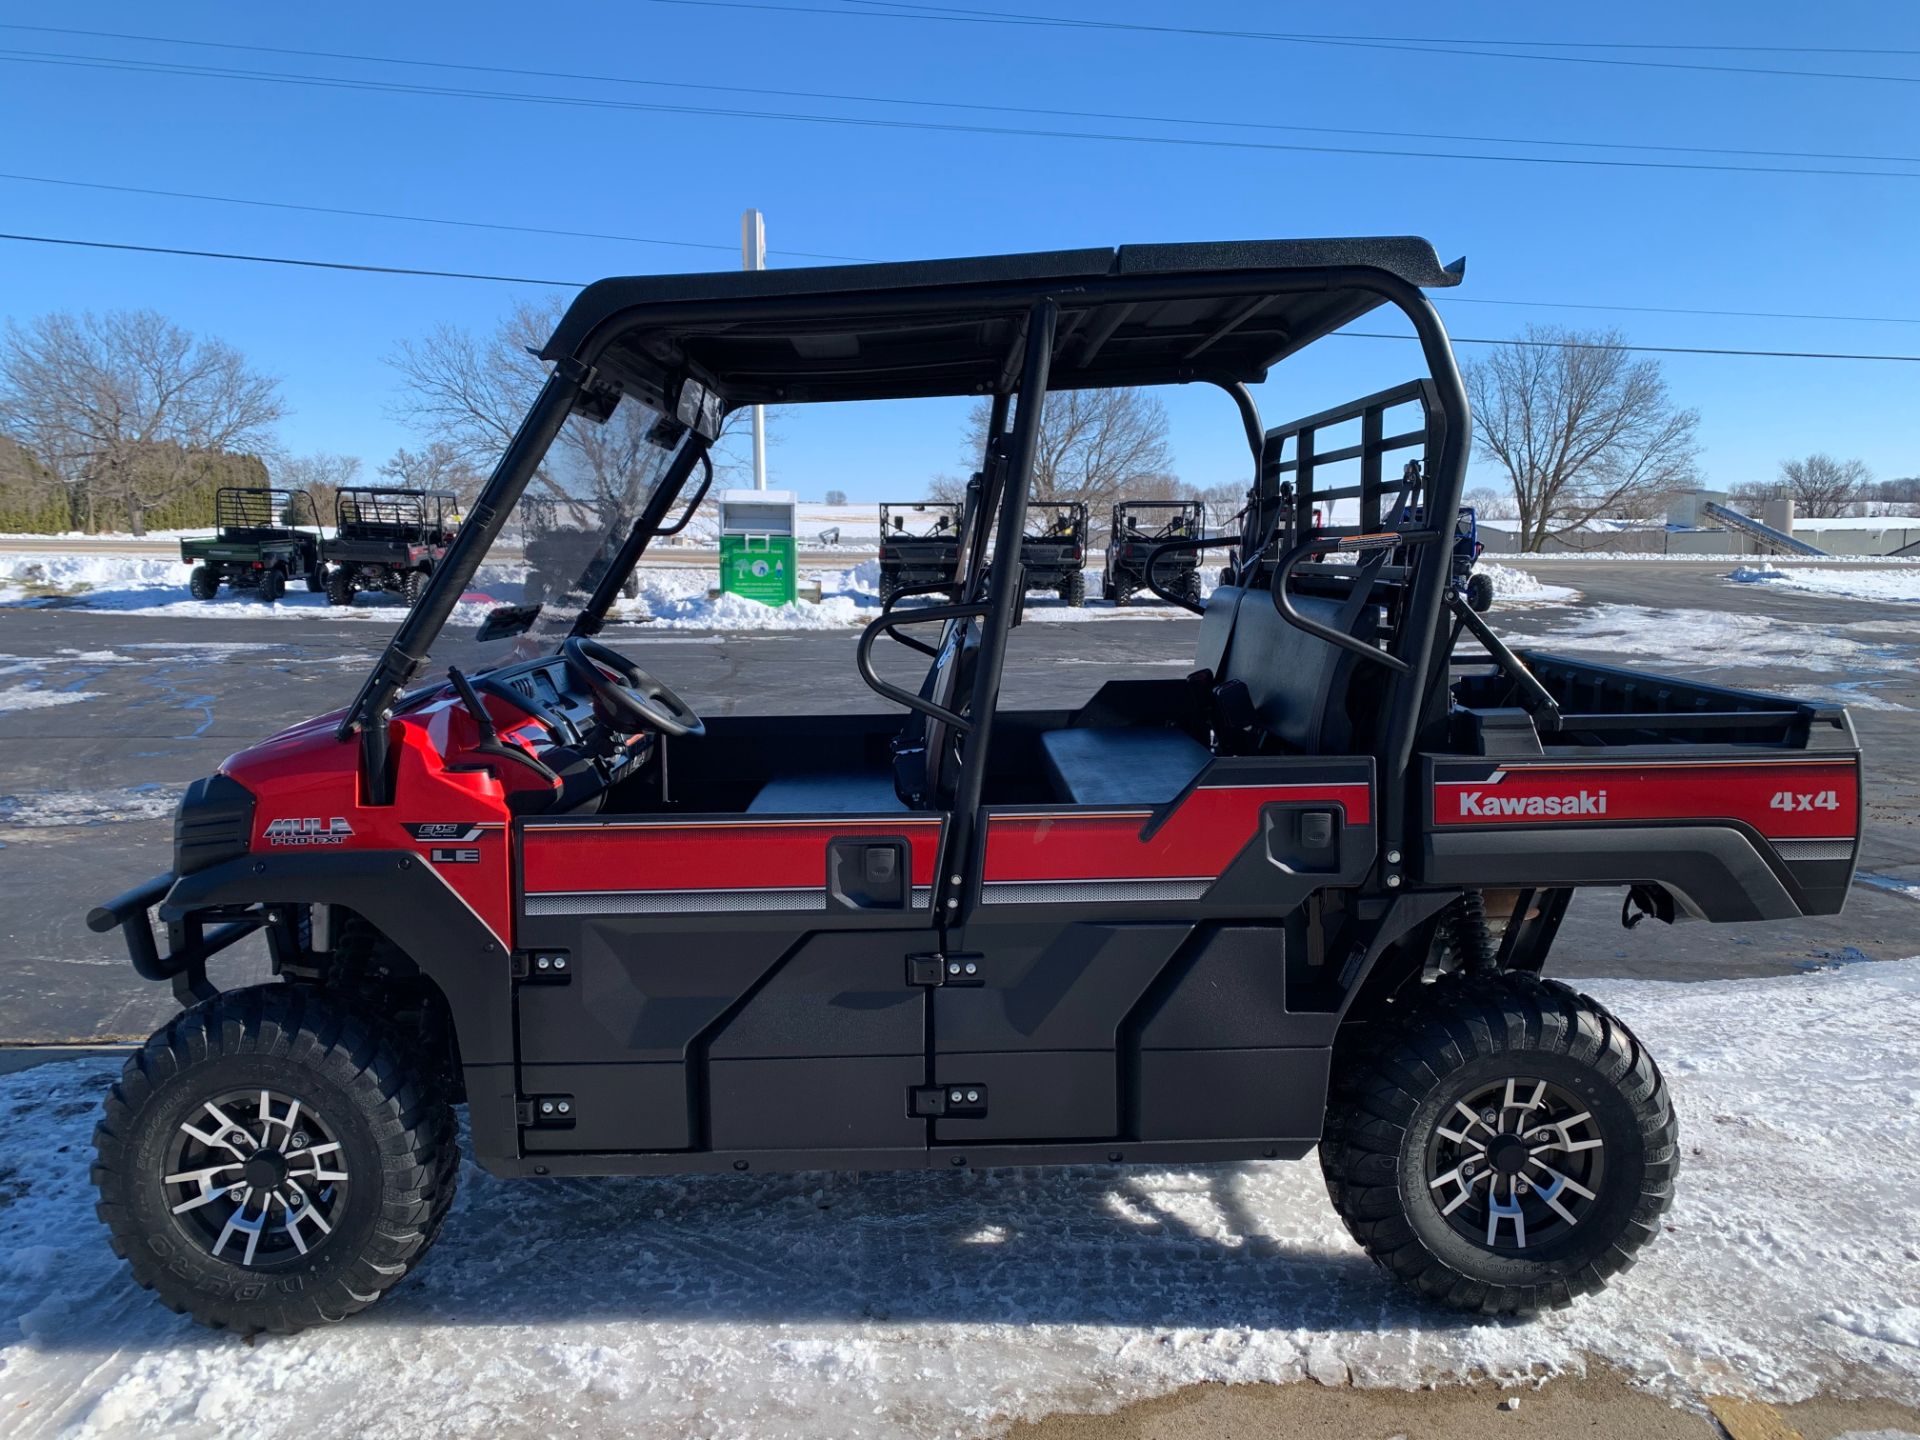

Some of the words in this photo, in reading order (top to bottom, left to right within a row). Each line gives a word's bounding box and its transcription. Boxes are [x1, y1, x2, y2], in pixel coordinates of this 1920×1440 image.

[1460, 790, 1607, 816] Kawasaki
[1770, 791, 1840, 812] 4x4
[264, 817, 356, 837] MULE
[432, 849, 479, 862] LE
